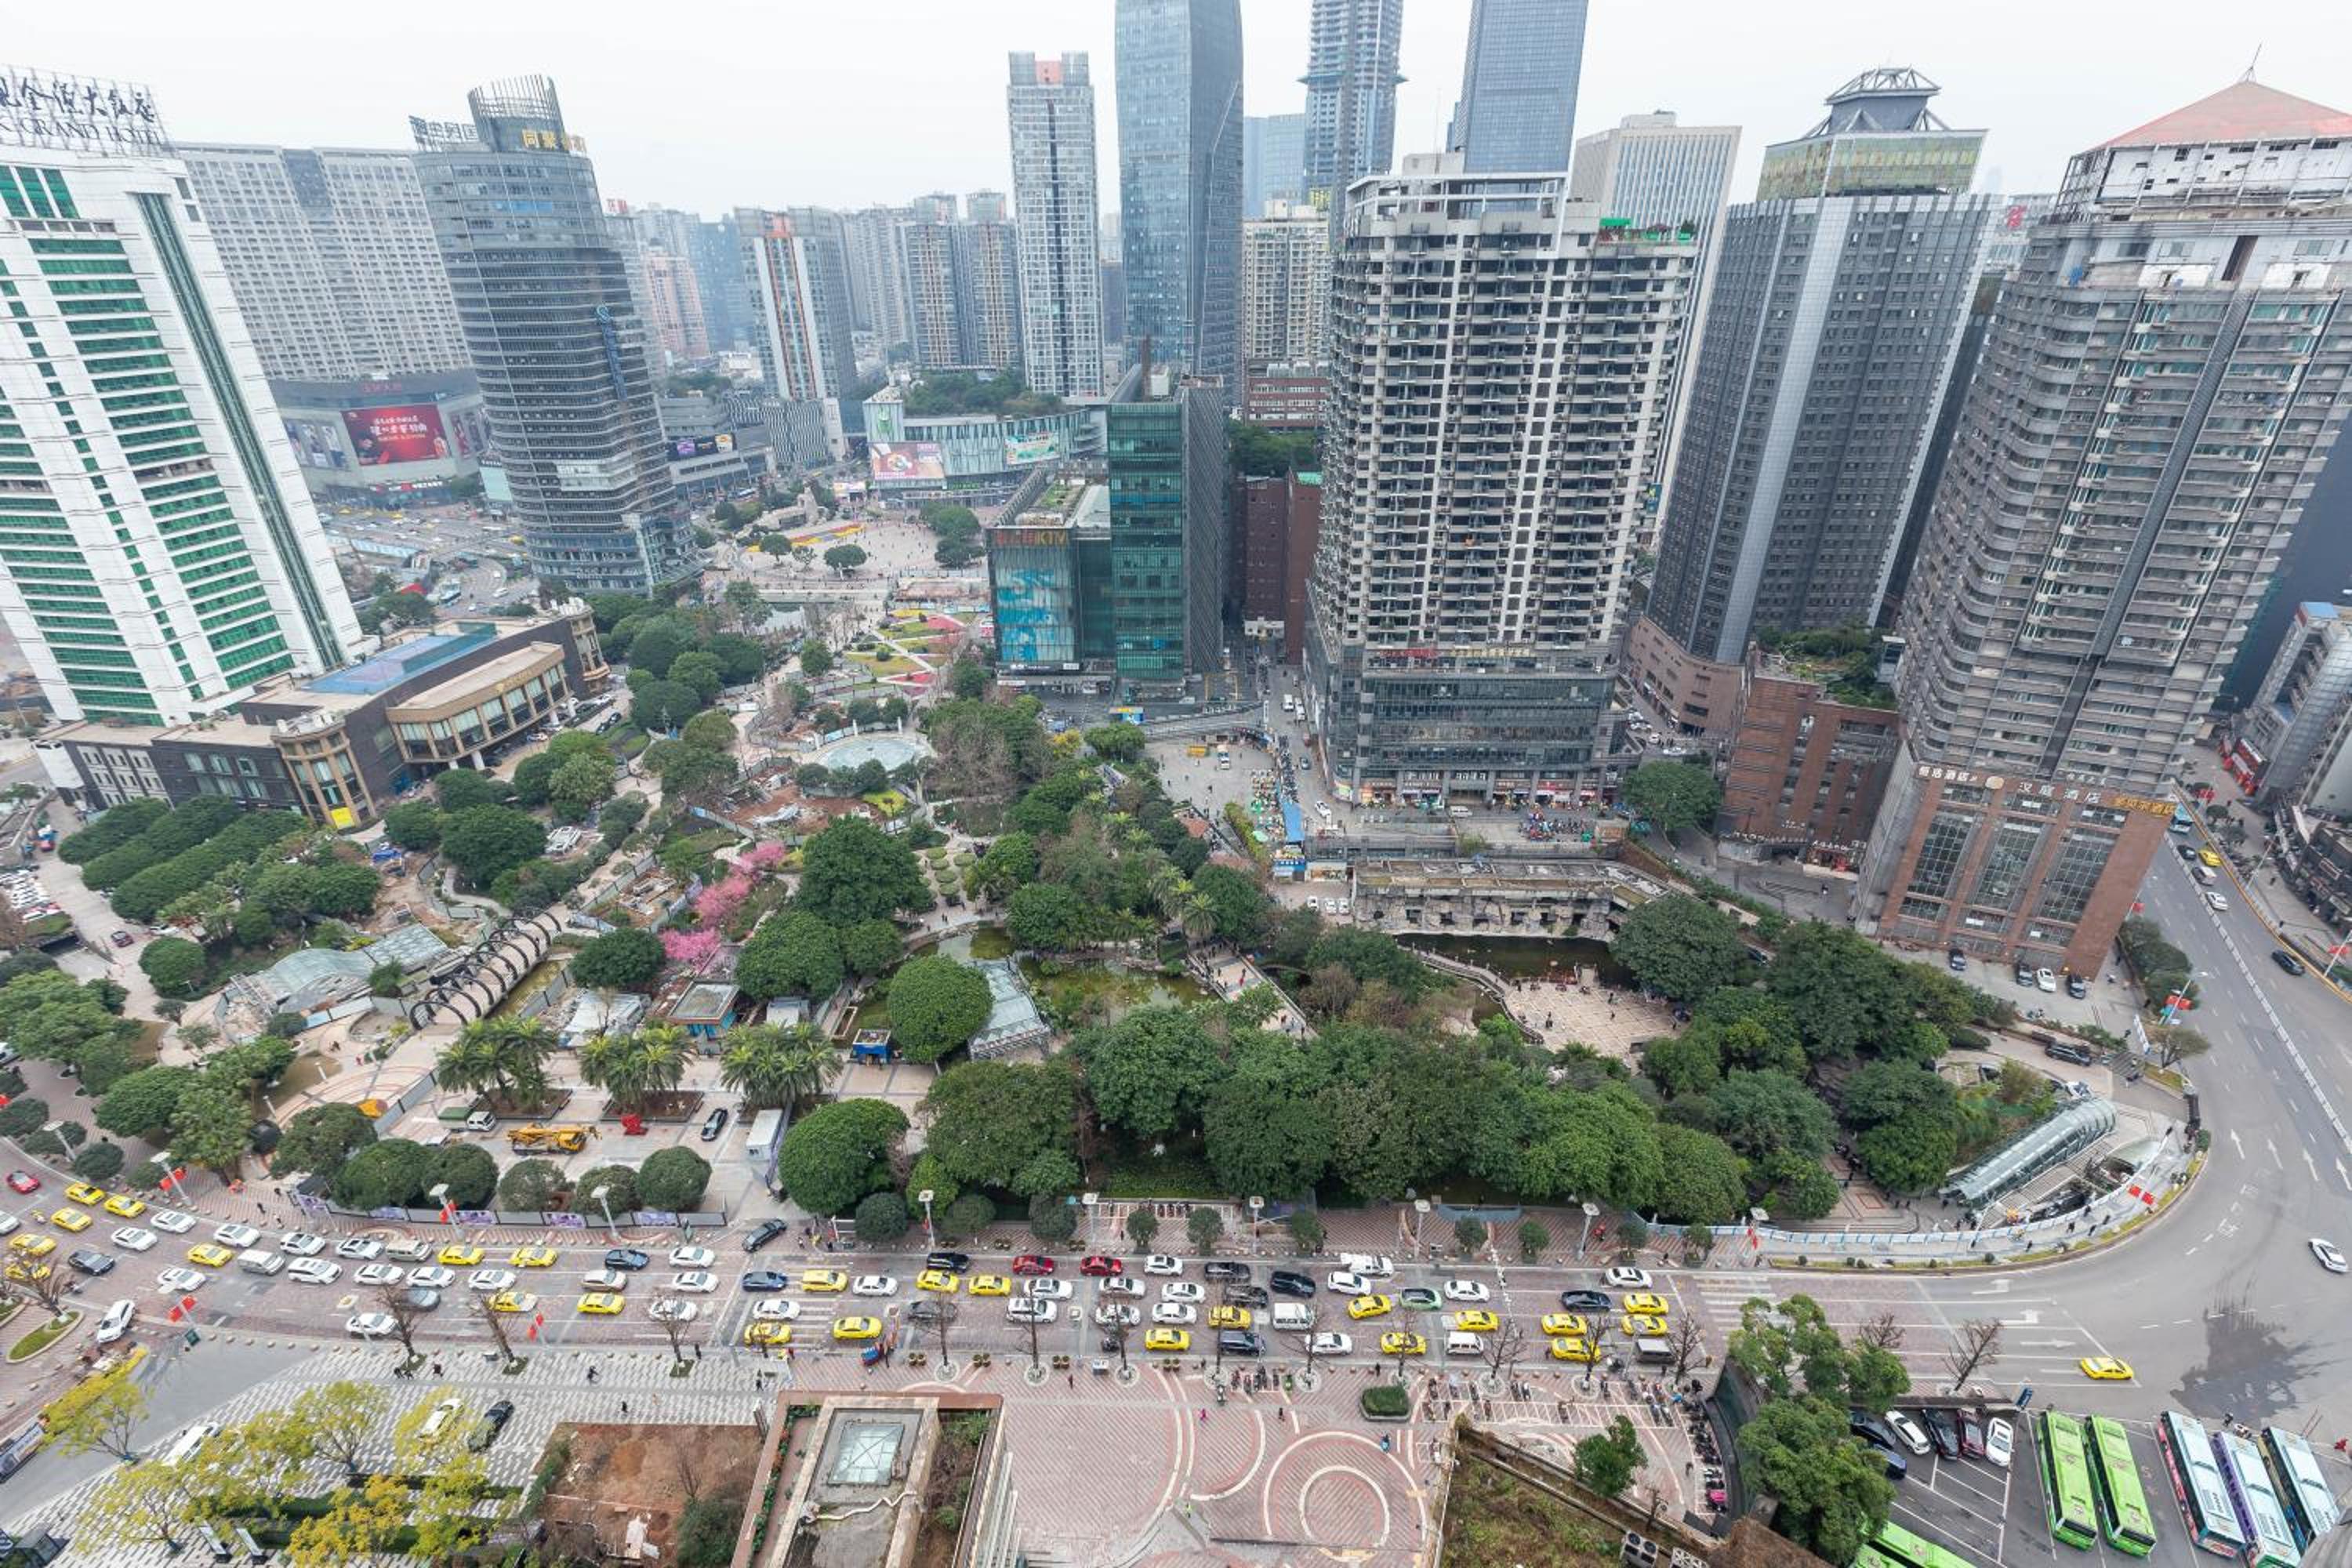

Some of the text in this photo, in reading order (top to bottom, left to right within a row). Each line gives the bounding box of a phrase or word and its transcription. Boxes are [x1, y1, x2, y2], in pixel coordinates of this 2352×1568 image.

[20, 118, 100, 140] GRAND
[106, 125, 162, 146] HOTEL
[2019, 781, 2103, 804] 汉庭酒店
